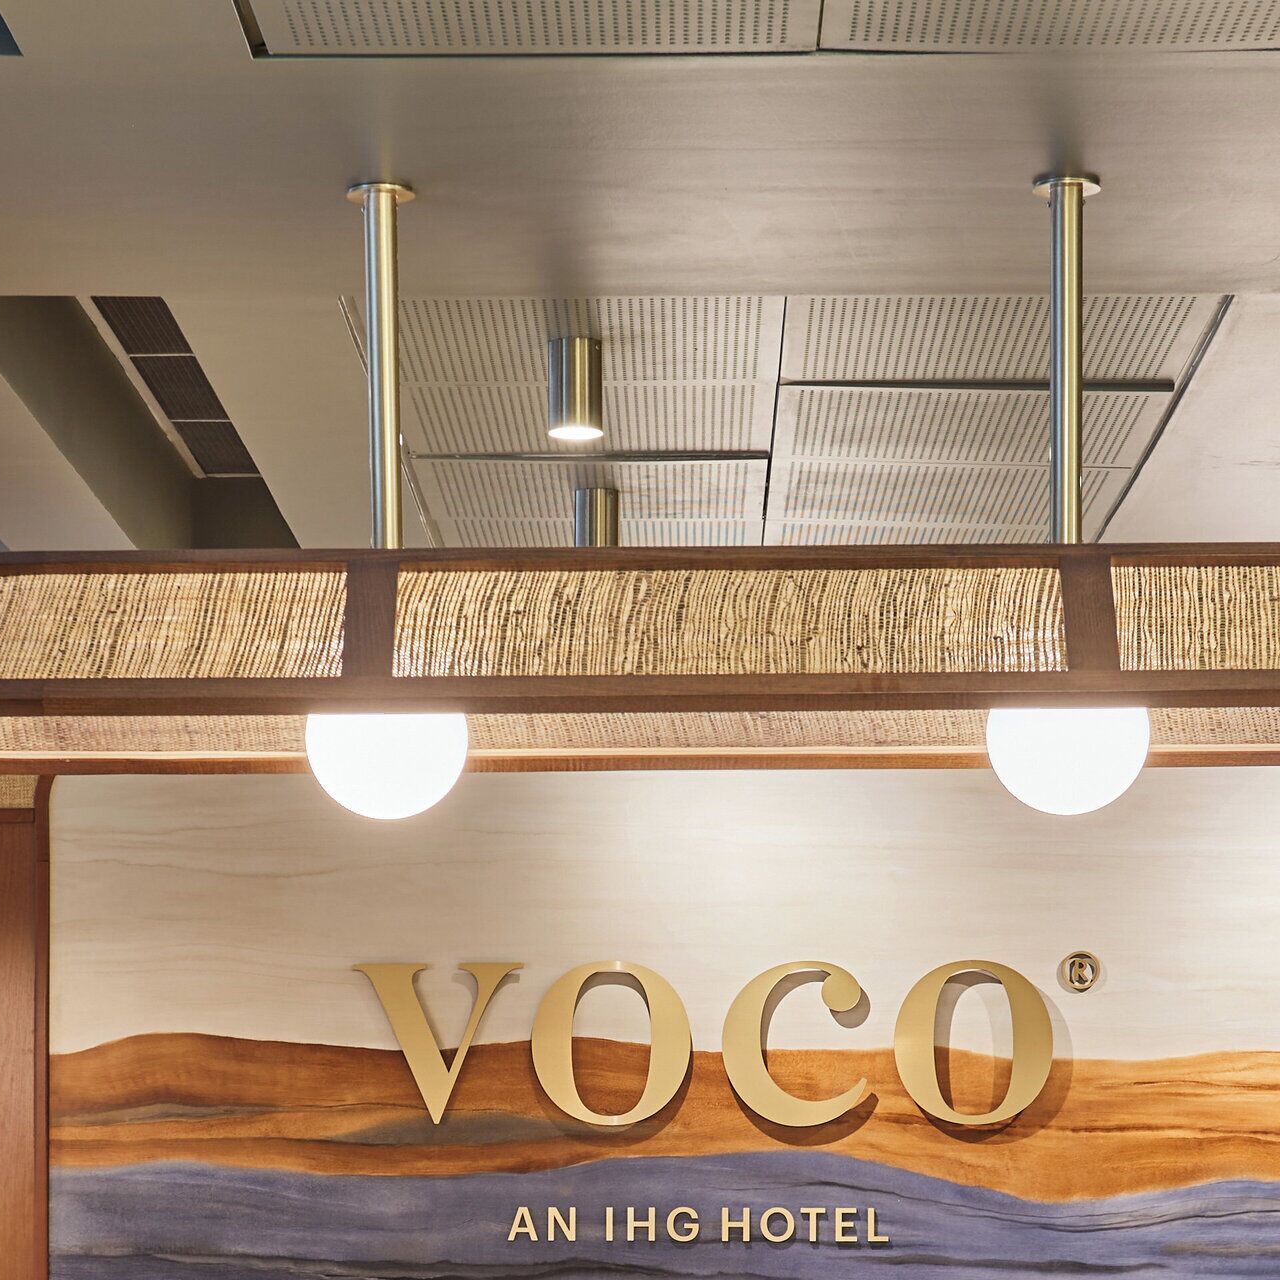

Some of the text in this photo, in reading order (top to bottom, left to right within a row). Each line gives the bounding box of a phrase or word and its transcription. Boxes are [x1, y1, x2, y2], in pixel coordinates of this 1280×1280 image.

[506, 1206, 891, 1243] AN IHG HOTEL
